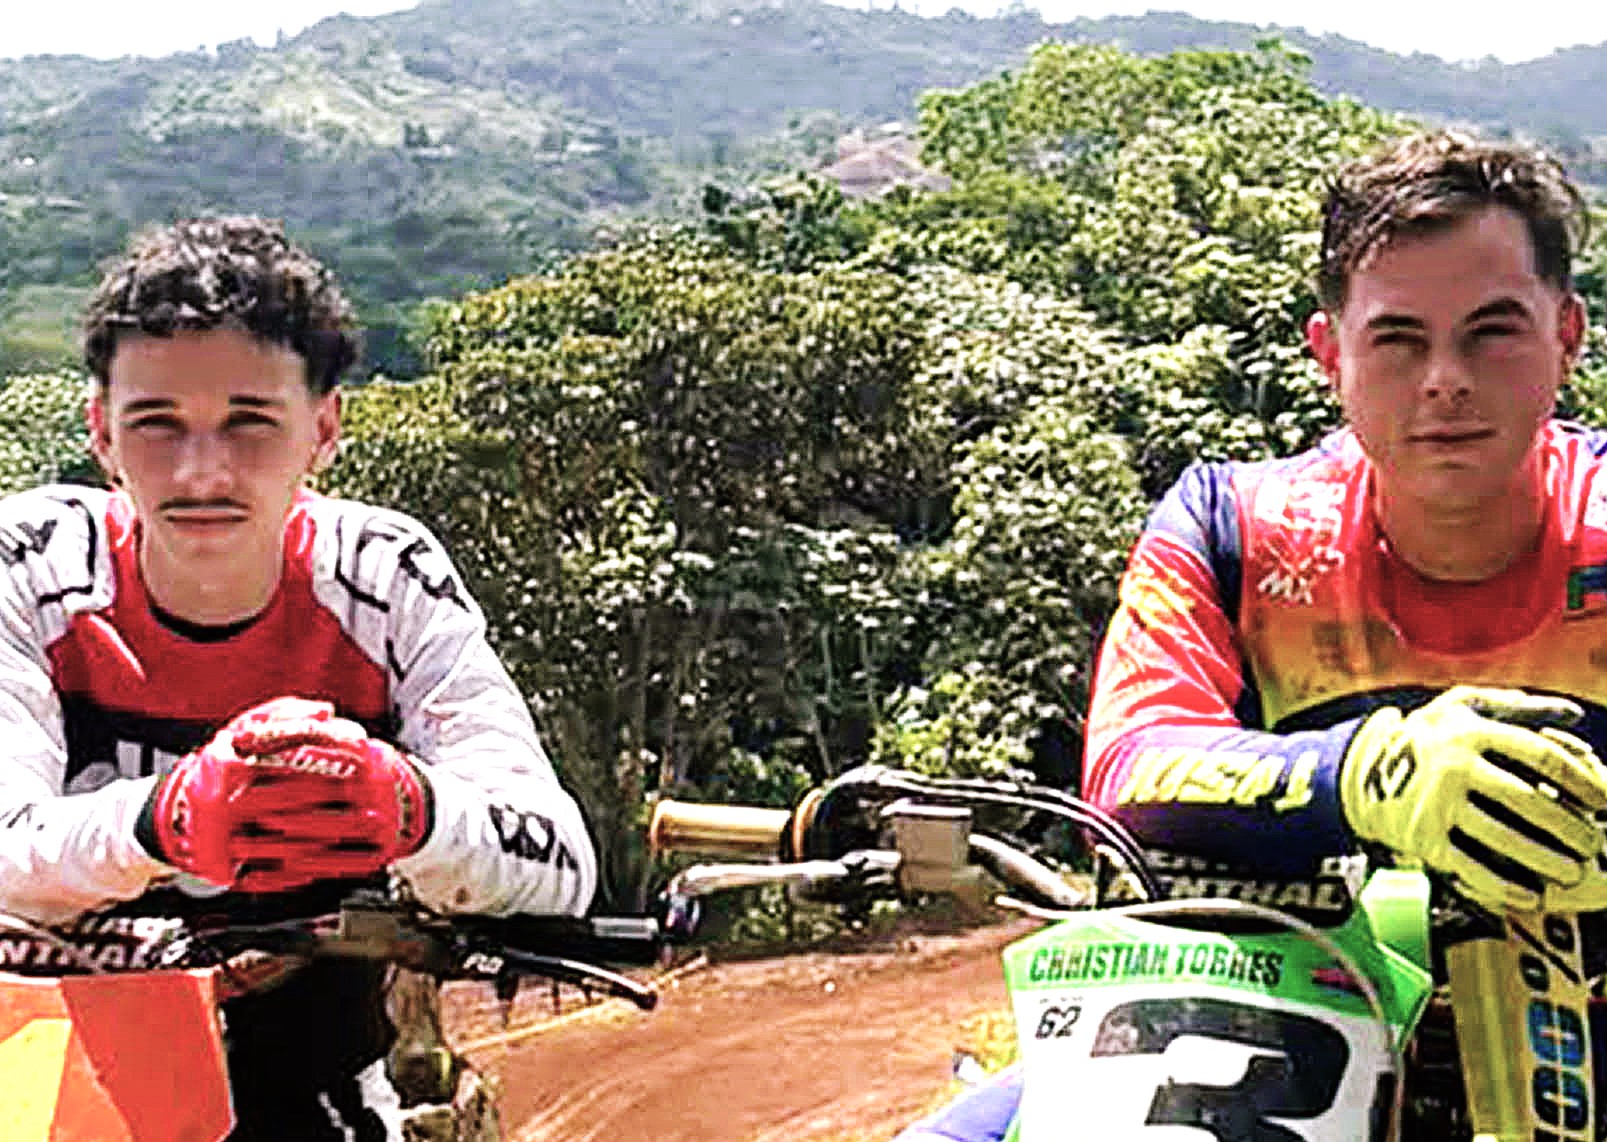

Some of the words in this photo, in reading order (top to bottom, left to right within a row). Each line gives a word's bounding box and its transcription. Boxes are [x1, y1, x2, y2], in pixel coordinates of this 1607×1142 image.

[1028, 946, 1171, 983] CHRISTIAN
[1173, 941, 1285, 989] TORRES
[1035, 1005, 1083, 1040] 62
